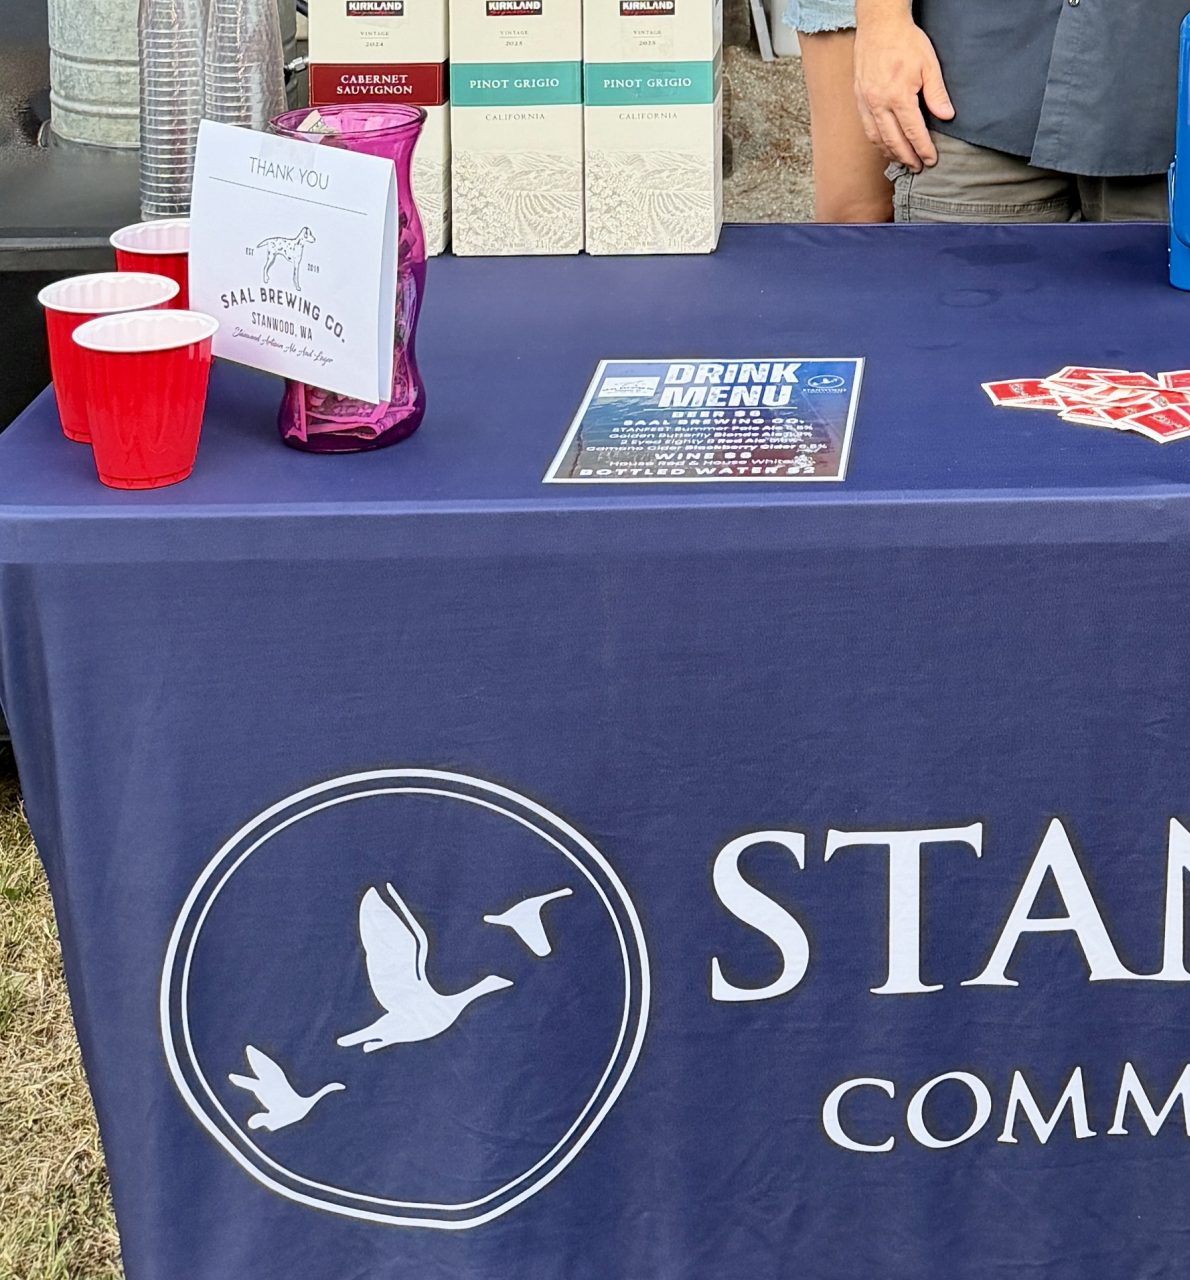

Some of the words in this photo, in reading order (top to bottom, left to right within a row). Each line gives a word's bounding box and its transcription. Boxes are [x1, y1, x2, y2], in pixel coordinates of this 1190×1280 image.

[349, 2, 402, 11] KIRKLAND
[489, 0, 541, 10] KIRKLAND
[622, 0, 674, 10] KIRKLAND
[341, 74, 408, 84] CABERNET
[469, 79, 510, 89] PINOT
[513, 78, 560, 88] GRIGIO
[603, 79, 643, 88] PINOT
[647, 77, 692, 88] GRIGIO
[336, 85, 413, 95] SAUVIGNON
[485, 113, 545, 121] CALIFORNIA
[619, 112, 678, 120] CALIFORNIA
[249, 156, 295, 184] THANK
[299, 167, 330, 190] YOU
[220, 287, 255, 309] SAAL
[260, 287, 321, 321] BREWING
[325, 314, 346, 343] CO.
[300, 325, 313, 341] WA
[664, 363, 802, 384] DRINK
[657, 385, 794, 408] MENU
[654, 452, 715, 460] WINE
[657, 459, 686, 467] Red
[579, 468, 686, 476] BOTTLED
[694, 466, 779, 475] WATER
